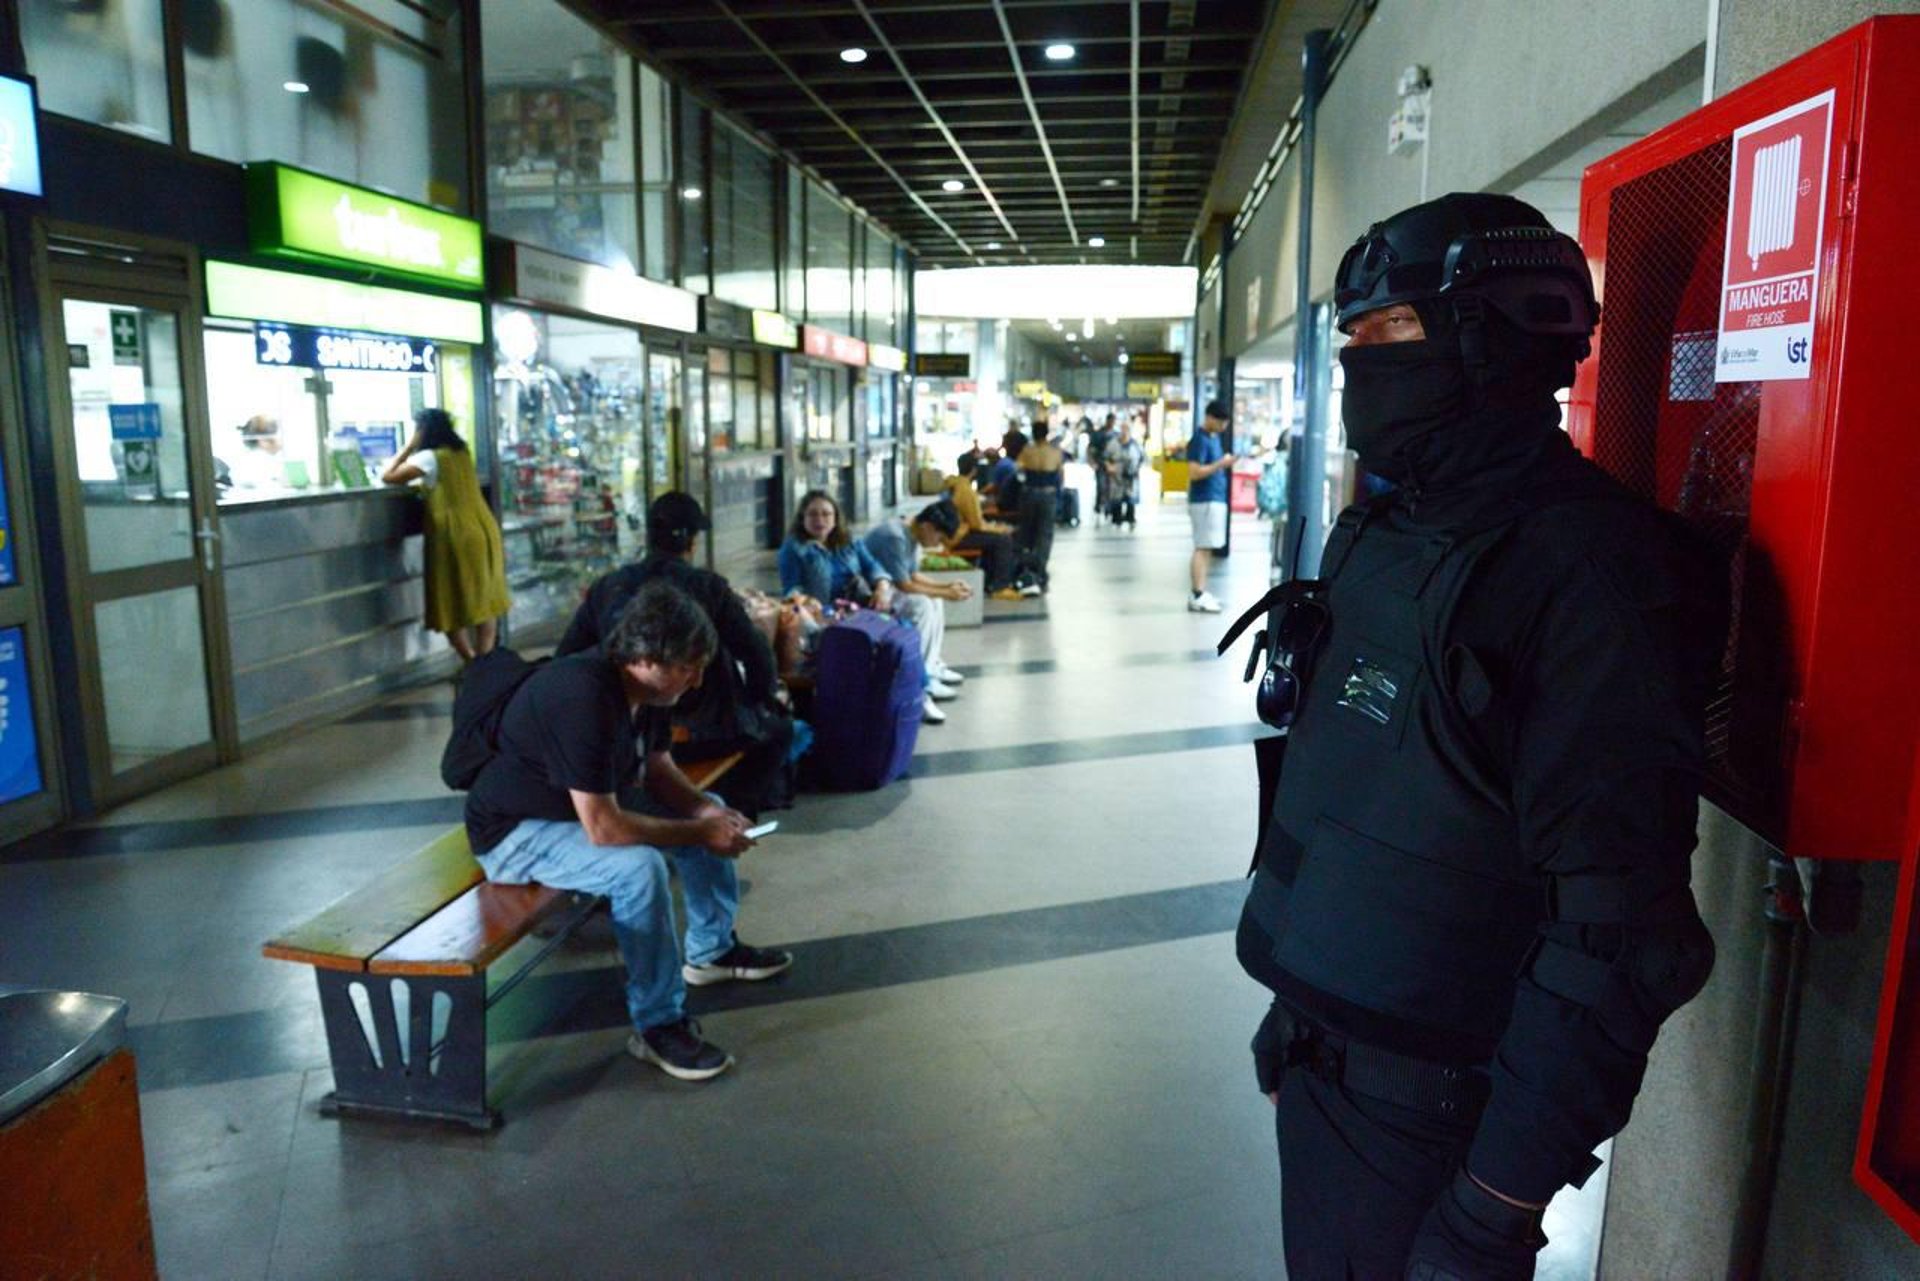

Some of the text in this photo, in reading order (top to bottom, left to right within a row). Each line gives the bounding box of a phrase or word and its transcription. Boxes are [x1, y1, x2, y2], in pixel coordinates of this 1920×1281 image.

[1729, 278, 1808, 312] MANGUERA
[1746, 309, 1786, 328] FIRE HOSE
[1787, 336, 1808, 363] ist
